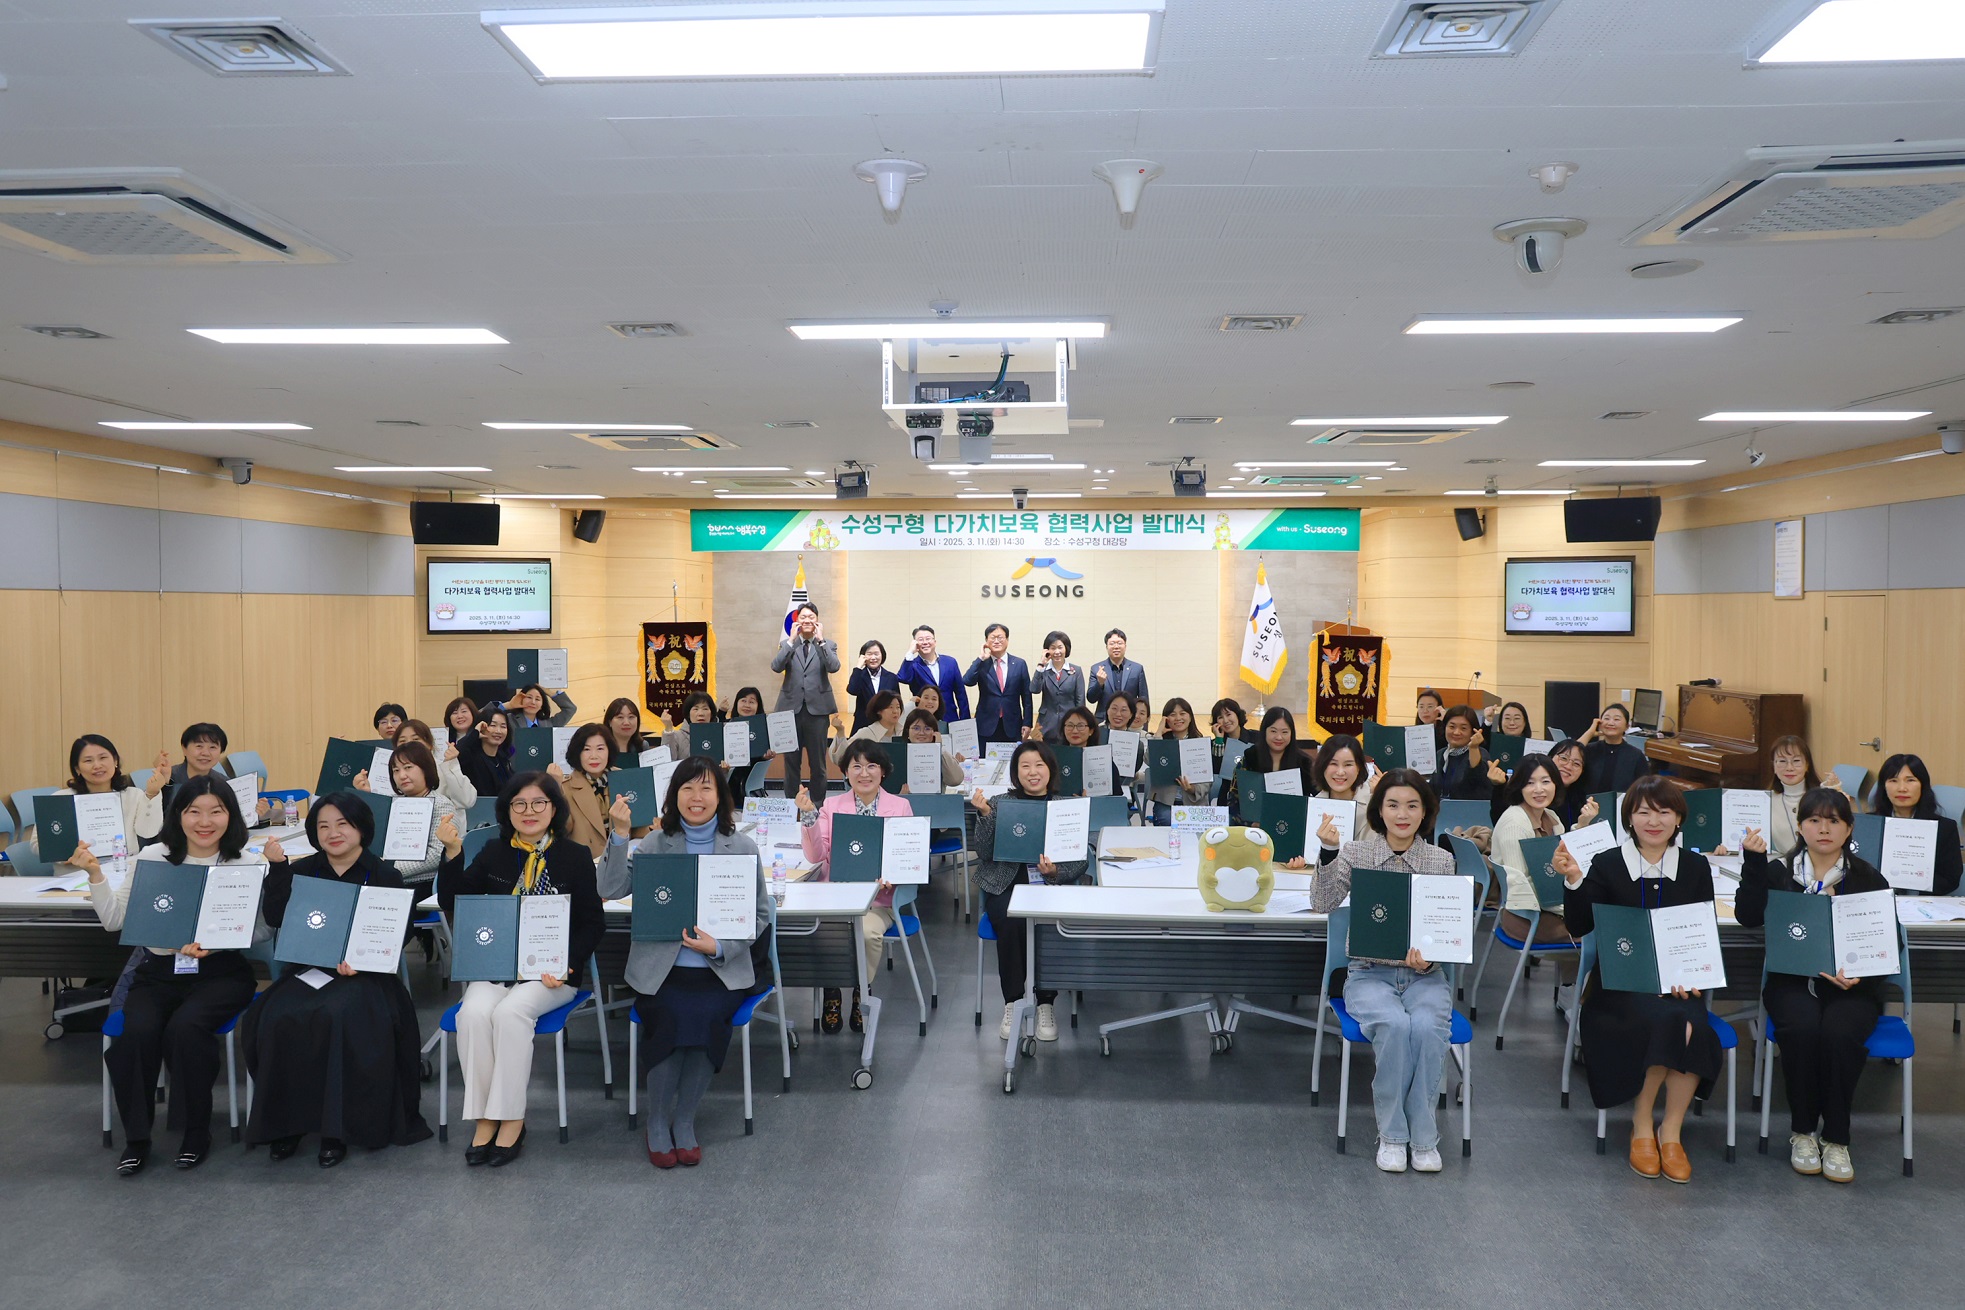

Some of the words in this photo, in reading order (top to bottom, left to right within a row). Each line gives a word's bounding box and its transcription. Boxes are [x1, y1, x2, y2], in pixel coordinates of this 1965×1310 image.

[841, 513, 925, 535] 수성구형
[934, 513, 1039, 534] 다가치보육
[1048, 513, 1133, 534] 협력사업
[1142, 513, 1206, 534] 발대식
[1303, 524, 1348, 536] Suseong
[919, 537, 936, 547] 일시
[1003, 538, 1025, 546] 14:30
[1044, 537, 1061, 546] 장소
[1068, 537, 1101, 546] 수성구청
[1102, 537, 1128, 546] 대강당
[444, 587, 481, 595] 다가치보육
[483, 587, 512, 595] 협력사업
[514, 587, 536, 595] 발대식
[981, 585, 1084, 598] SUSEONG
[1521, 587, 1558, 595] 다가치보육
[1560, 587, 1590, 595] 협력사업
[1592, 587, 1615, 595] 발대식
[668, 634, 682, 649] 祝
[1343, 647, 1356, 662] 祝
